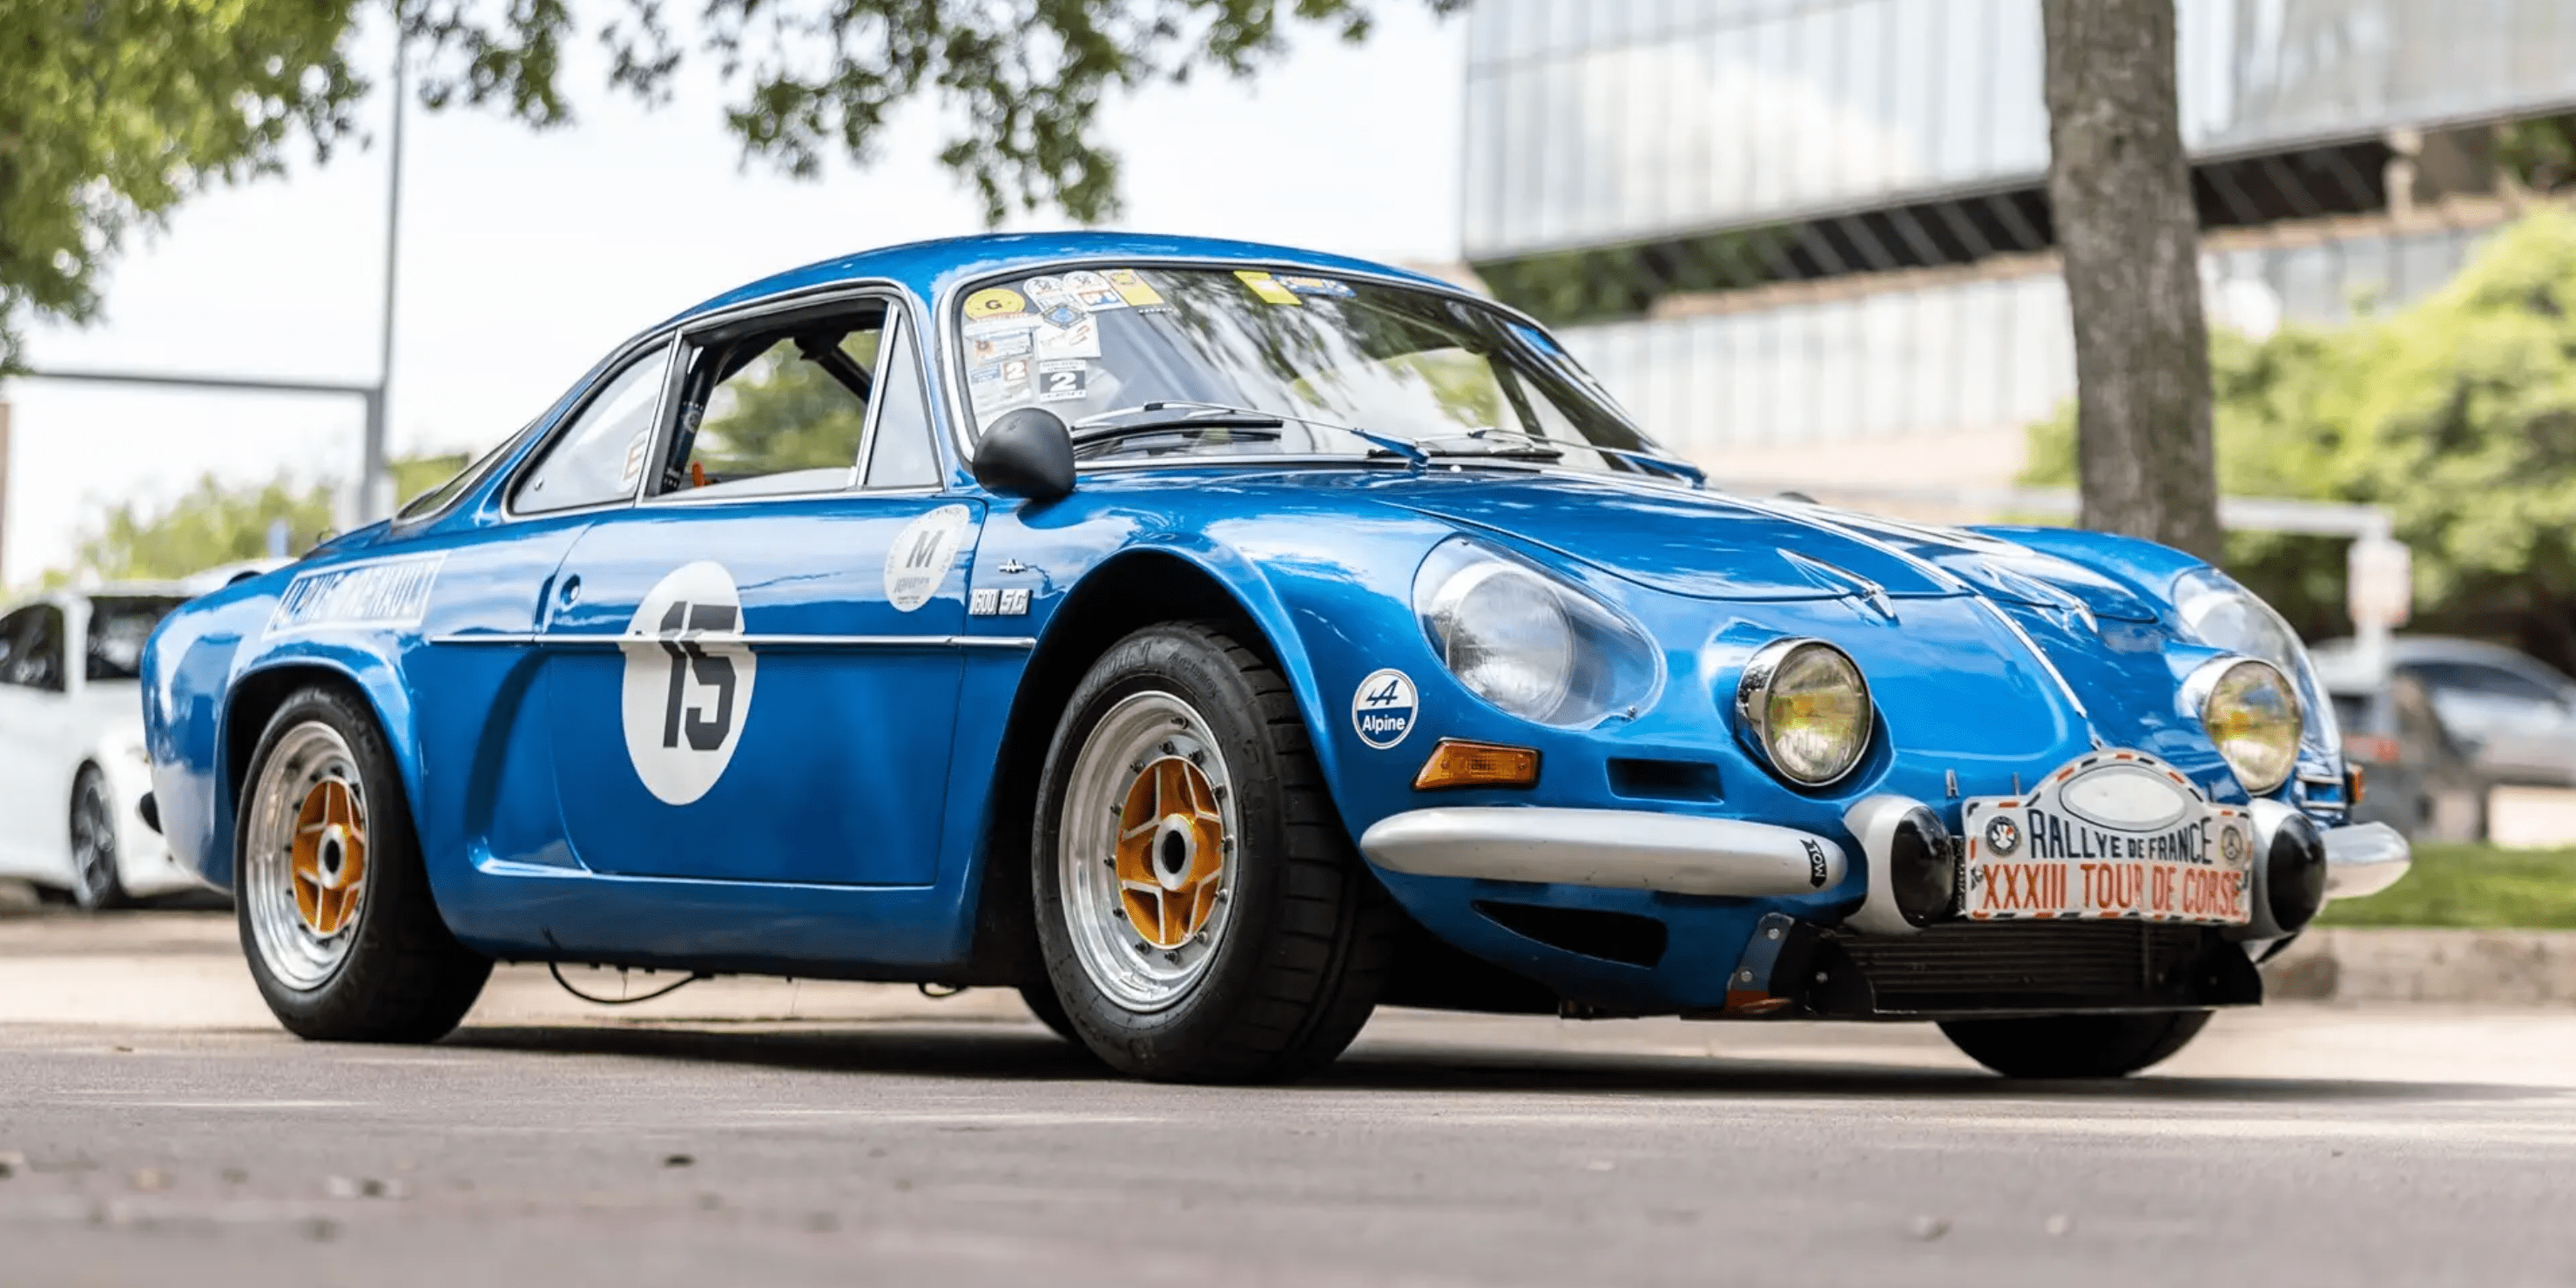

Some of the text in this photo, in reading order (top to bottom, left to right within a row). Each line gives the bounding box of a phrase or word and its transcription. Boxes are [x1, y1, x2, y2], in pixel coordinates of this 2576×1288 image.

[1006, 361, 1025, 377] 2
[1049, 372, 1076, 392] 2
[906, 530, 946, 568] M
[658, 601, 738, 751] 15
[1362, 714, 1406, 735] Alpine
[2027, 809, 2213, 865] RALLYE DE FRANCE
[1809, 844, 1826, 877] TOW
[1982, 863, 2242, 916] XXXIII TOUR DE CORSE
